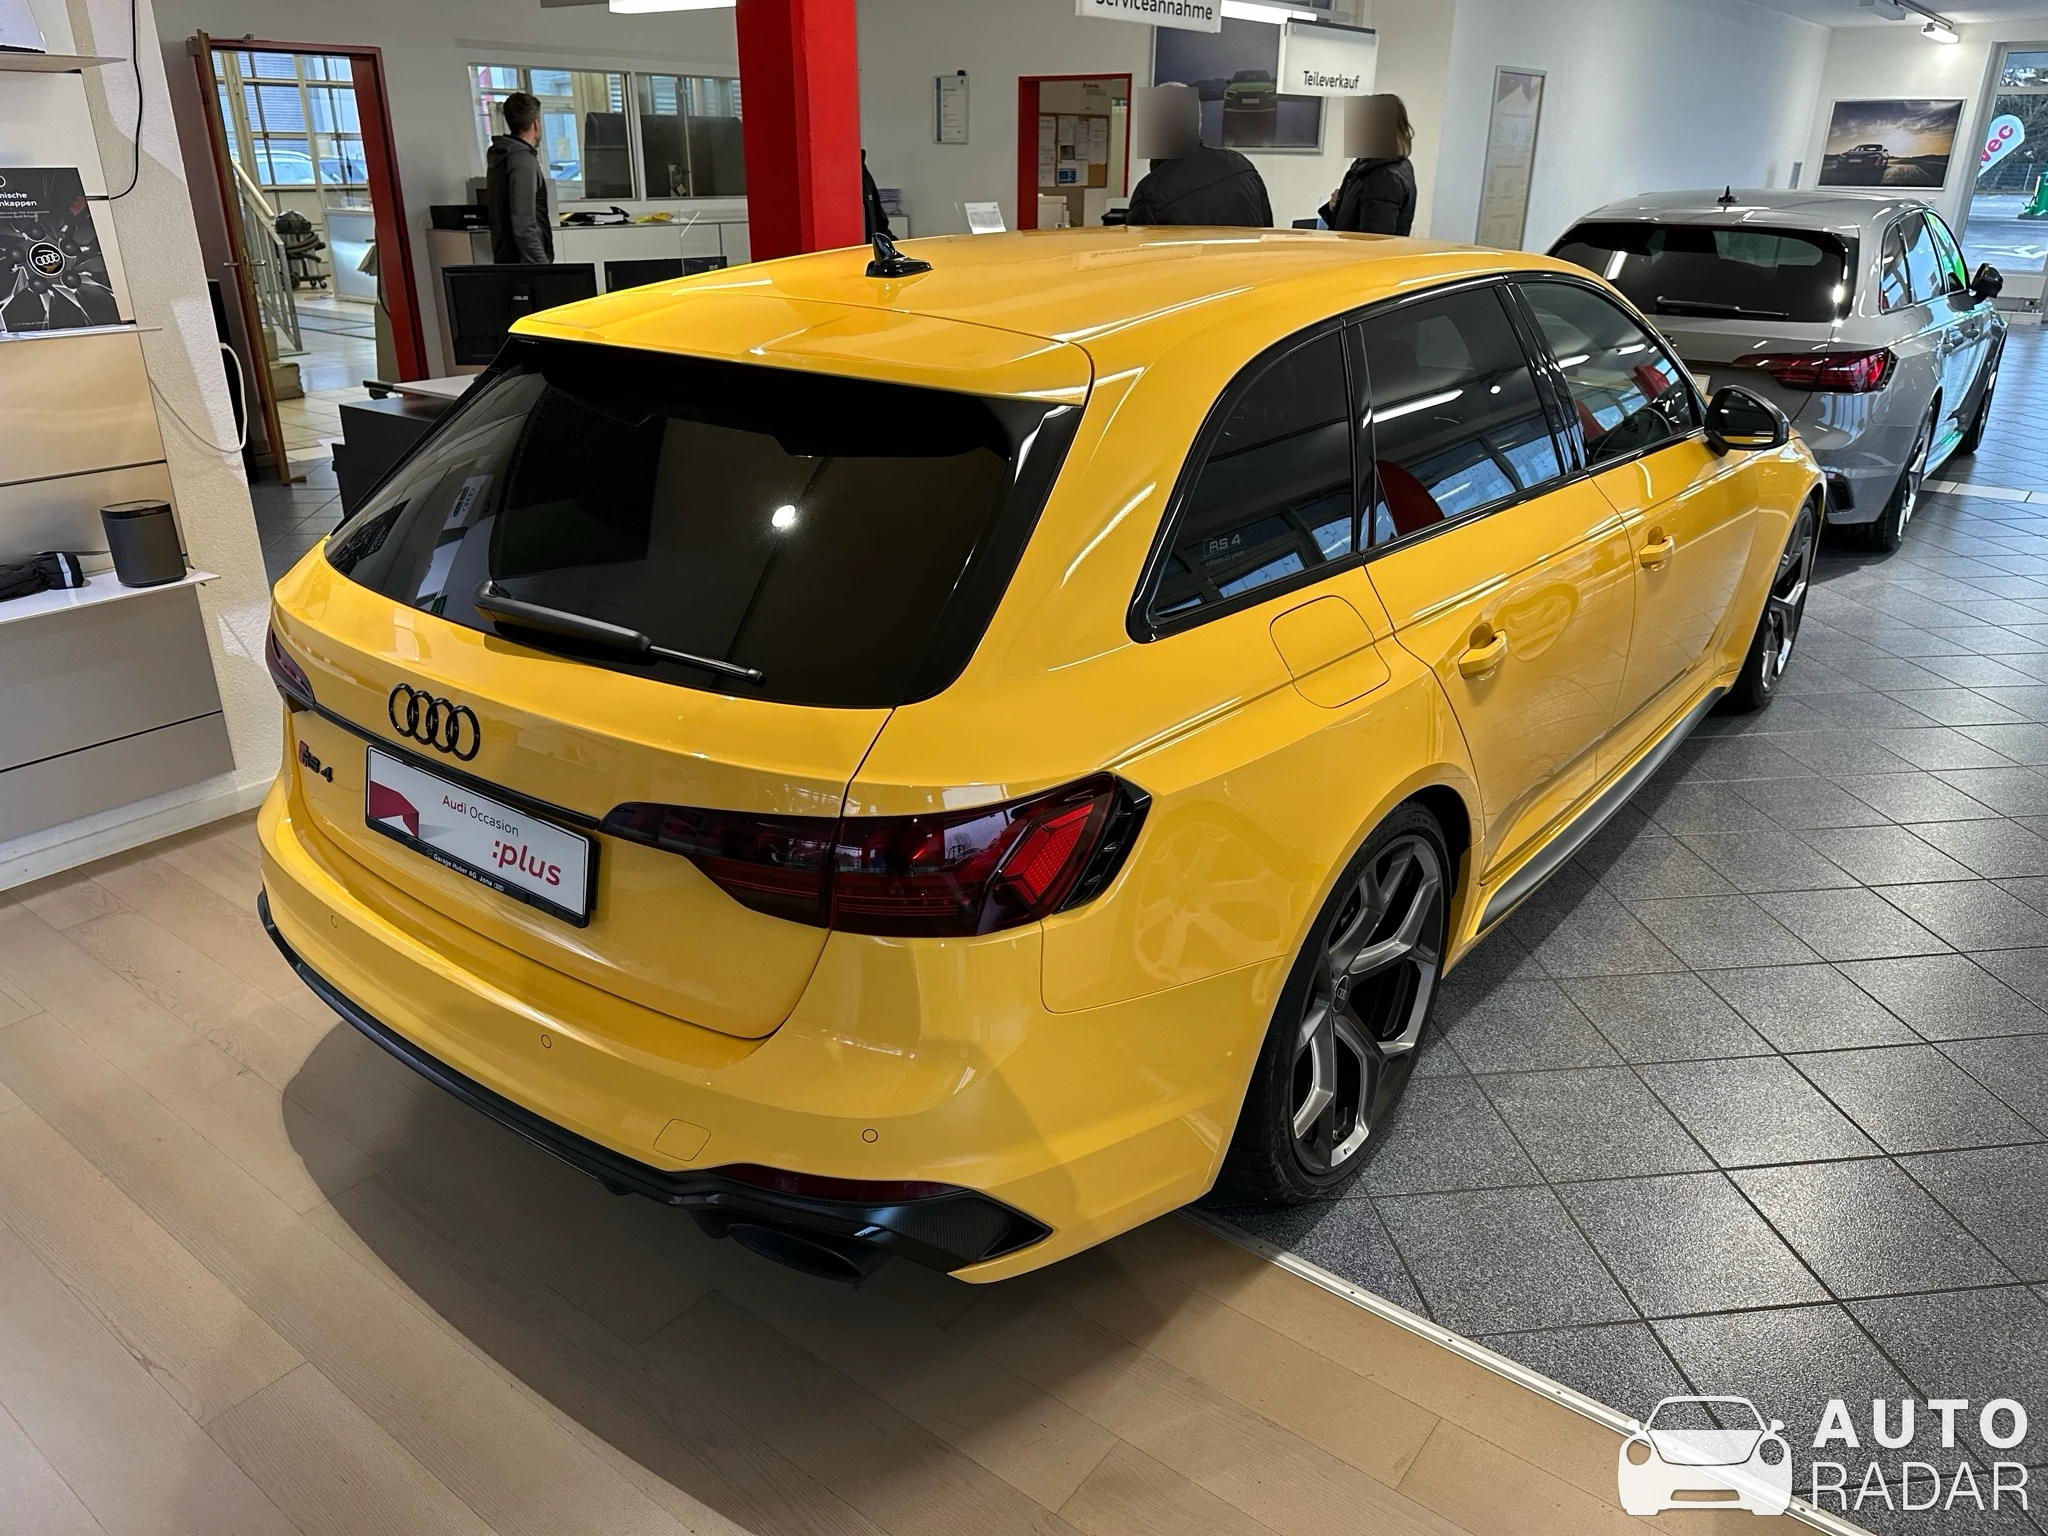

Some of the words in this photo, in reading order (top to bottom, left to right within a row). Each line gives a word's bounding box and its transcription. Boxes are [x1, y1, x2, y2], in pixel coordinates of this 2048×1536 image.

[1096, 0, 1212, 20] rviceannahme
[1303, 70, 1359, 89] Teileverkauf
[1980, 125, 2013, 169] vec
[1207, 537, 1228, 554] RS
[1231, 534, 1241, 545] 4
[321, 767, 333, 783] 4
[442, 795, 467, 814] Audi
[469, 806, 519, 837] Occasion
[433, 853, 452, 867] Garage
[453, 862, 468, 875] Huber
[468, 870, 477, 879] AG
